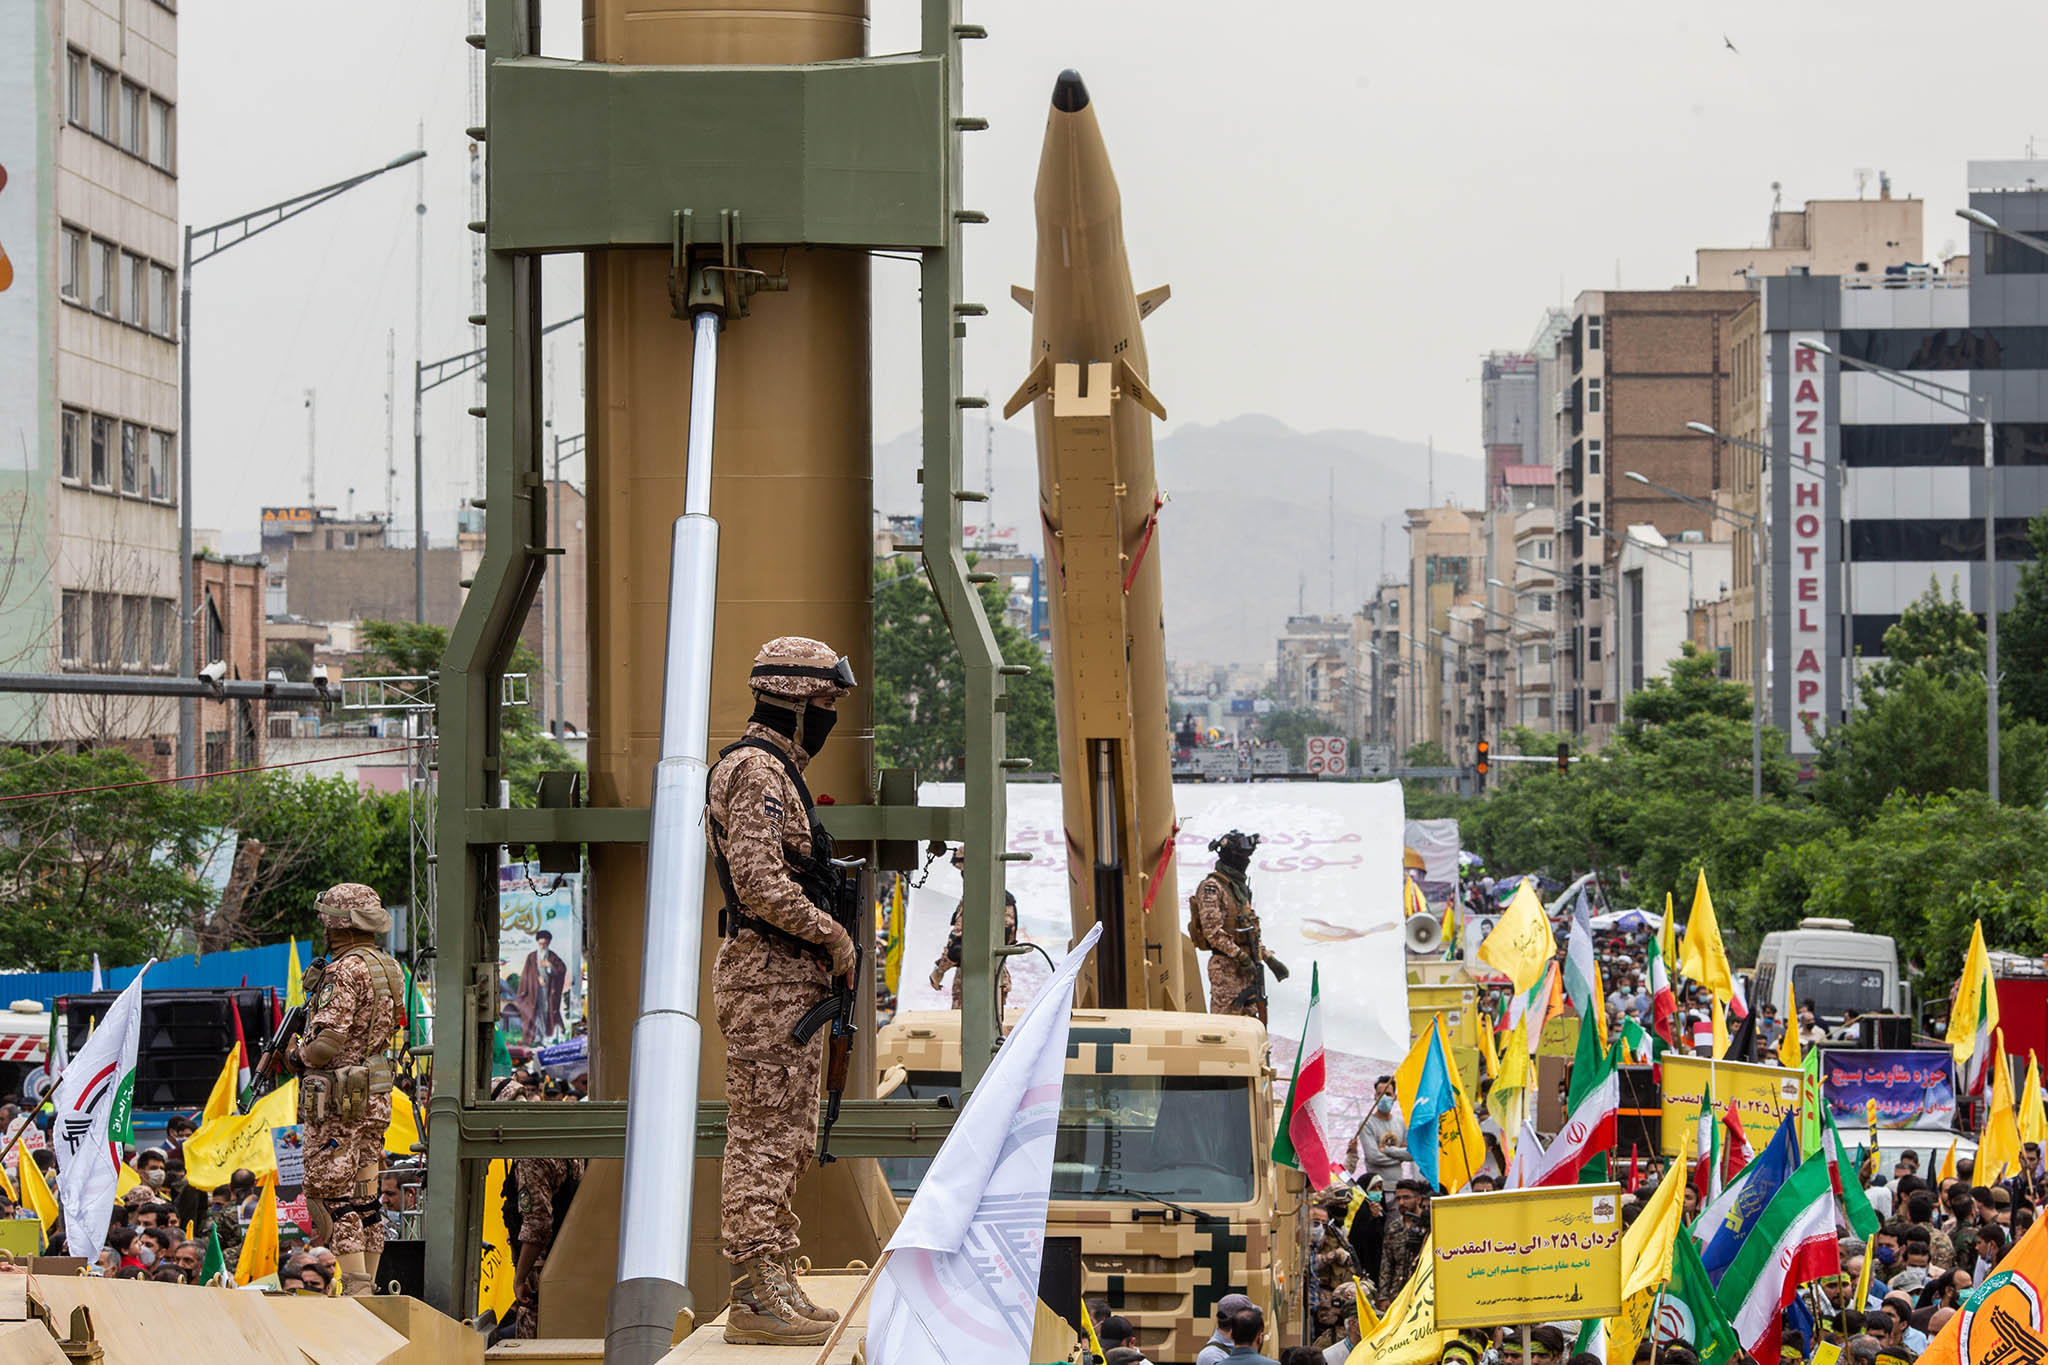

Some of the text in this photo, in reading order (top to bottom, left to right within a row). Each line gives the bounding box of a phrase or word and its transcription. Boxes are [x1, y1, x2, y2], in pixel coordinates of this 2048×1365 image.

[1794, 348, 1821, 736] RAZI HOTEL APT
[1832, 1064, 1946, 1088] حوزه مقاومت بسیج
[1749, 1101, 1770, 1114] ۲۴۵
[1550, 1231, 1577, 1249] ۲۵۹
[1580, 1229, 1620, 1250] گردان
[1495, 1241, 1517, 1255] بیت
[1521, 1264, 1539, 1275] بسیج
[1540, 1260, 1568, 1272] مقاومت
[1570, 1257, 1590, 1269] ناحیه
[1466, 1266, 1486, 1279] عقیل
[1501, 1264, 1519, 1276] مسلم
